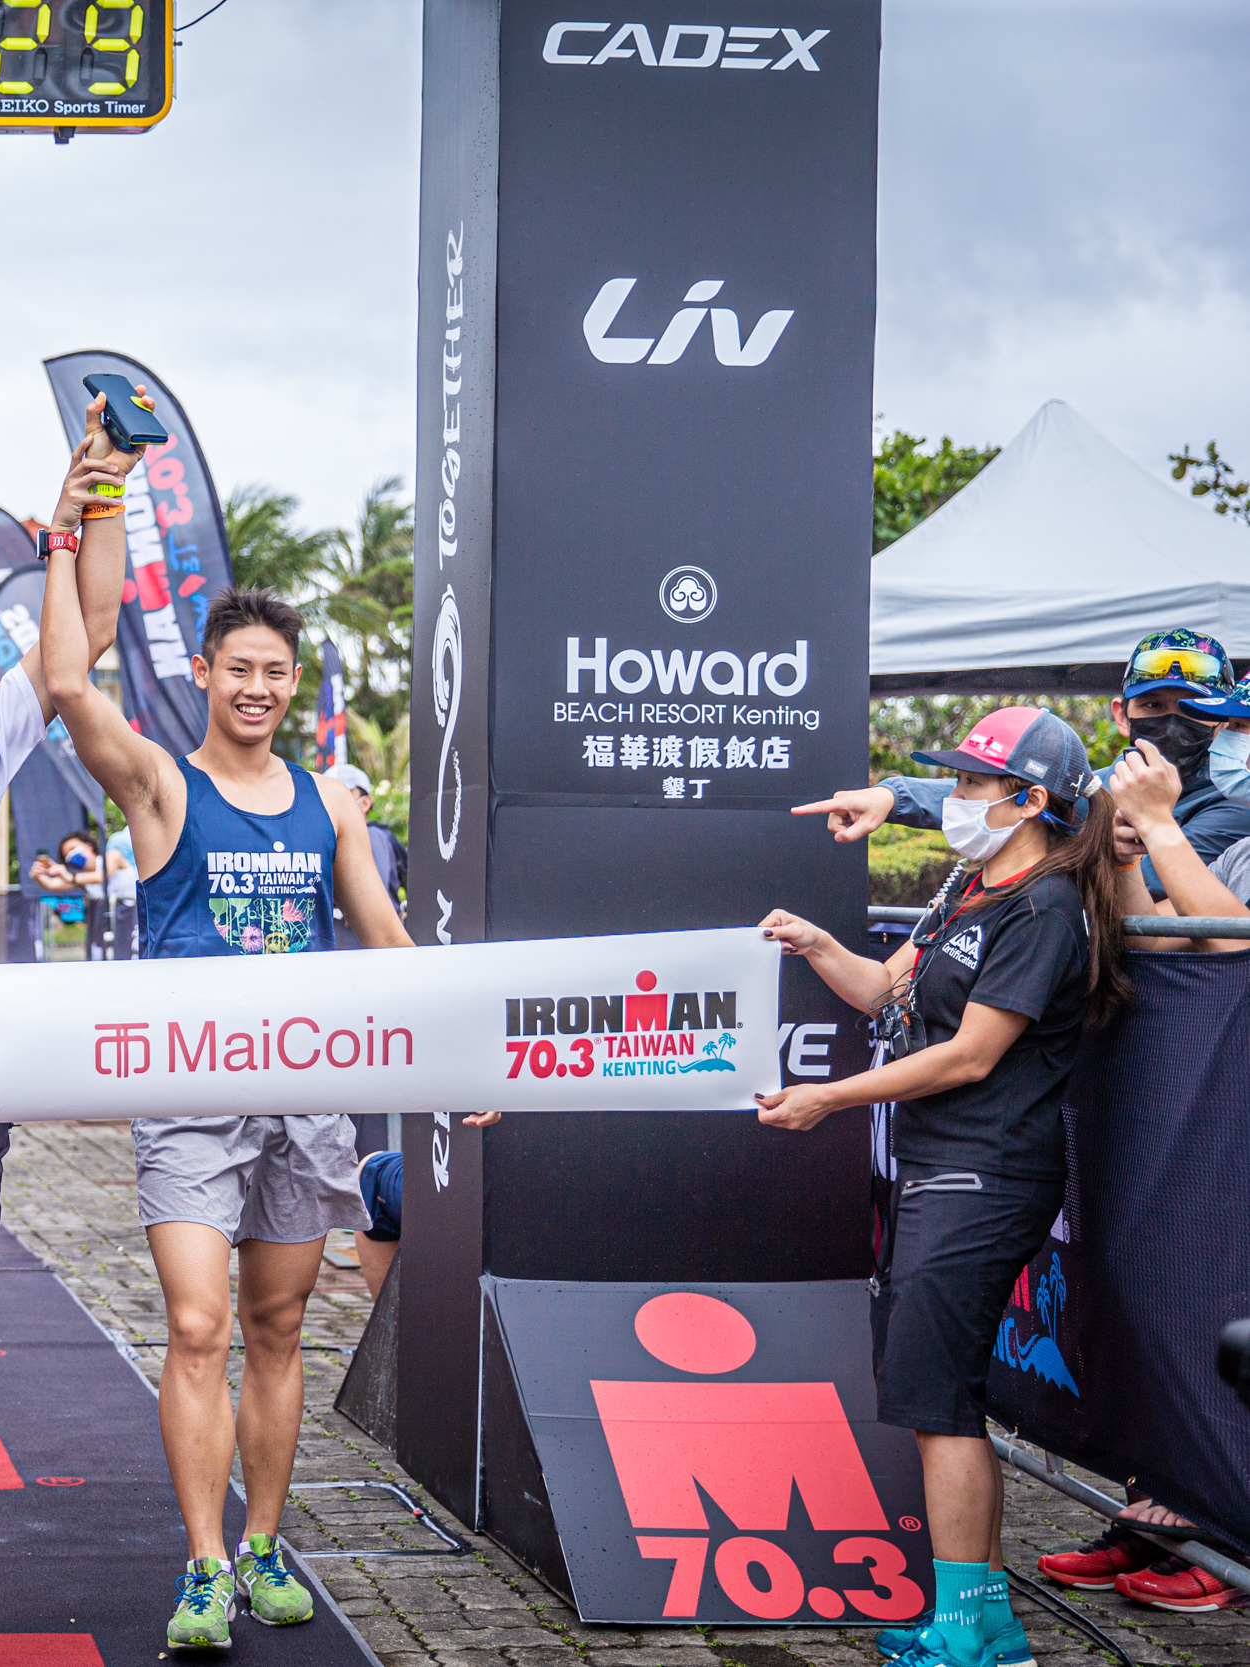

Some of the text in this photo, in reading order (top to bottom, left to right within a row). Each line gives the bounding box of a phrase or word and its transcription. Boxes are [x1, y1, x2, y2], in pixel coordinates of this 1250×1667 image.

[543, 22, 830, 71] CADEX
[54, 101, 99, 116] Sports
[105, 101, 145, 114] Timer
[583, 277, 794, 366] Liv
[437, 221, 464, 570] TOGETHER
[566, 637, 808, 697] Howard
[554, 702, 820, 730] BEACH RESORT Kenting
[582, 734, 791, 770] 福華渡假飯店
[662, 776, 710, 799] 墾丁
[207, 841, 322, 873] IRONMAN
[208, 873, 304, 894] 70.3 TAIWAN
[258, 886, 295, 894] KENTING
[942, 942, 978, 971] Certificated
[505, 970, 737, 1036] IRONMAN
[168, 1015, 413, 1073] MaiCoin
[506, 1033, 694, 1079] 70.3 TAIWAN
[603, 1061, 676, 1077] KENTING
[636, 1536, 925, 1621] 70.3
